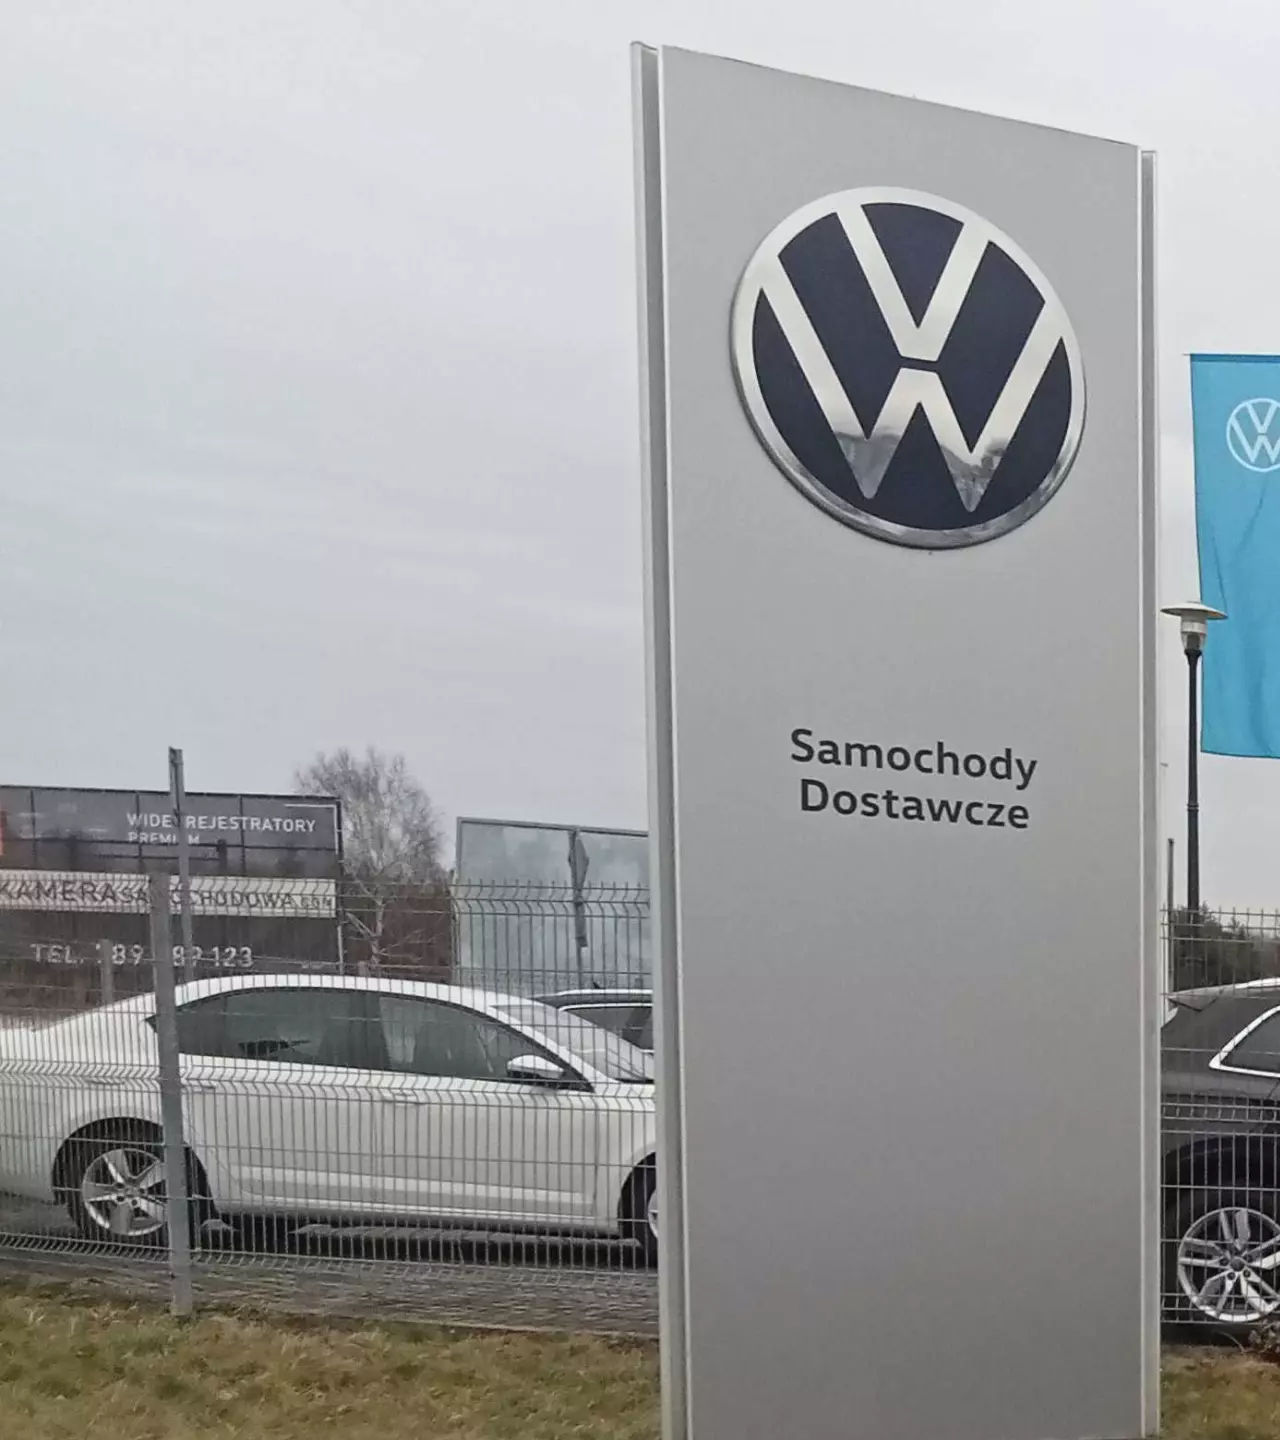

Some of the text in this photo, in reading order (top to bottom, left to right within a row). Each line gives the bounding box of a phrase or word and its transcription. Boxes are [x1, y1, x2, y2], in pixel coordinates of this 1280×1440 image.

[790, 728, 1038, 791] Samochody
[801, 778, 1030, 829] Dostawcze
[126, 812, 316, 833] WIDEREJESTRATORY
[128, 831, 201, 845] PREMIM
[212, 946, 253, 968] 123
